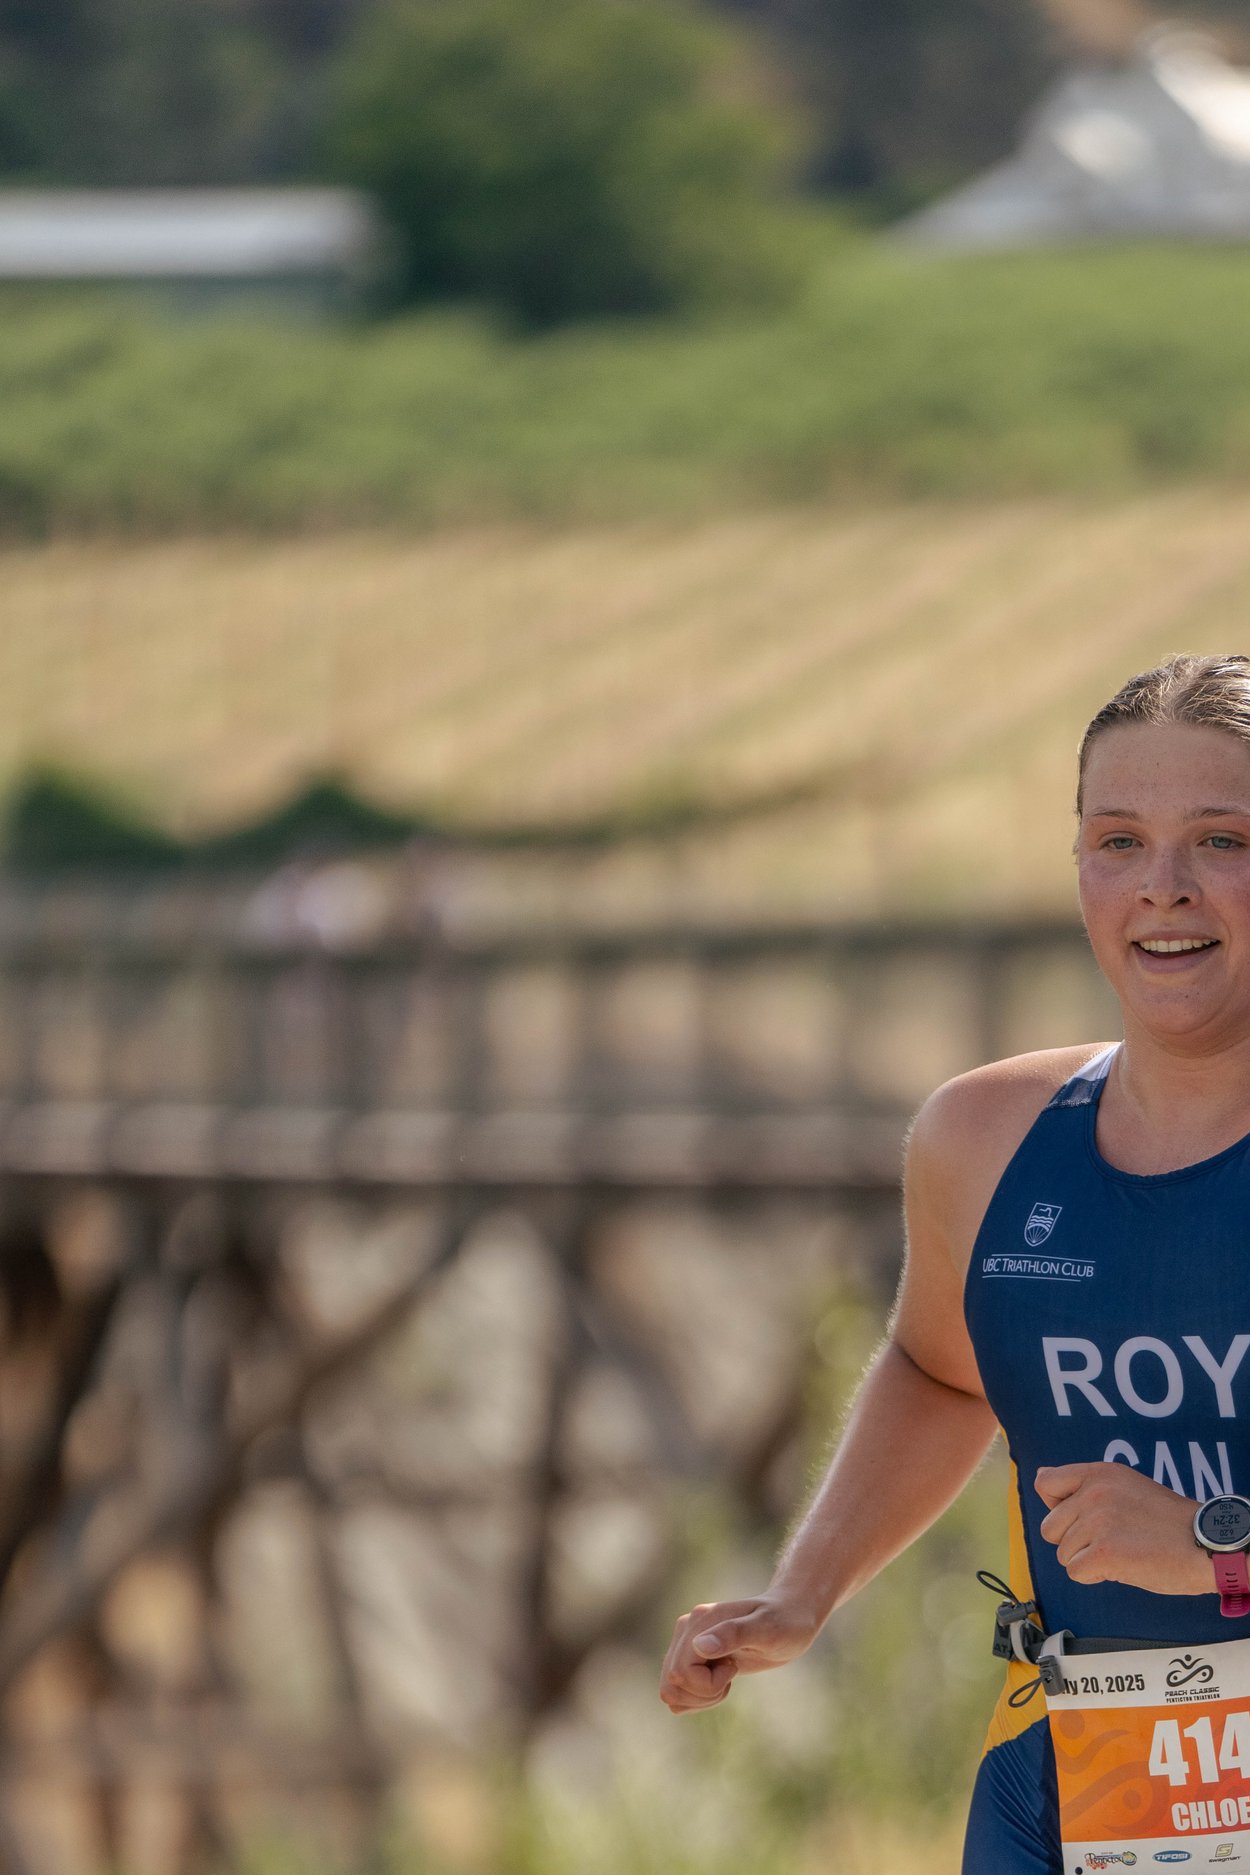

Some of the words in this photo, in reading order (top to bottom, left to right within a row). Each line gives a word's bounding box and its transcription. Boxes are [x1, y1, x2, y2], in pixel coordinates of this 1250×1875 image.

[983, 1258, 1001, 1272] UBC
[1002, 1258, 1060, 1275] TRIATHLON
[1061, 1262, 1094, 1277] CLUB
[1213, 1514, 1241, 1526] 32:24
[1080, 1676, 1104, 1695] 20,
[1105, 1674, 1146, 1693] 2025
[1190, 1686, 1220, 1695] CLASSIC
